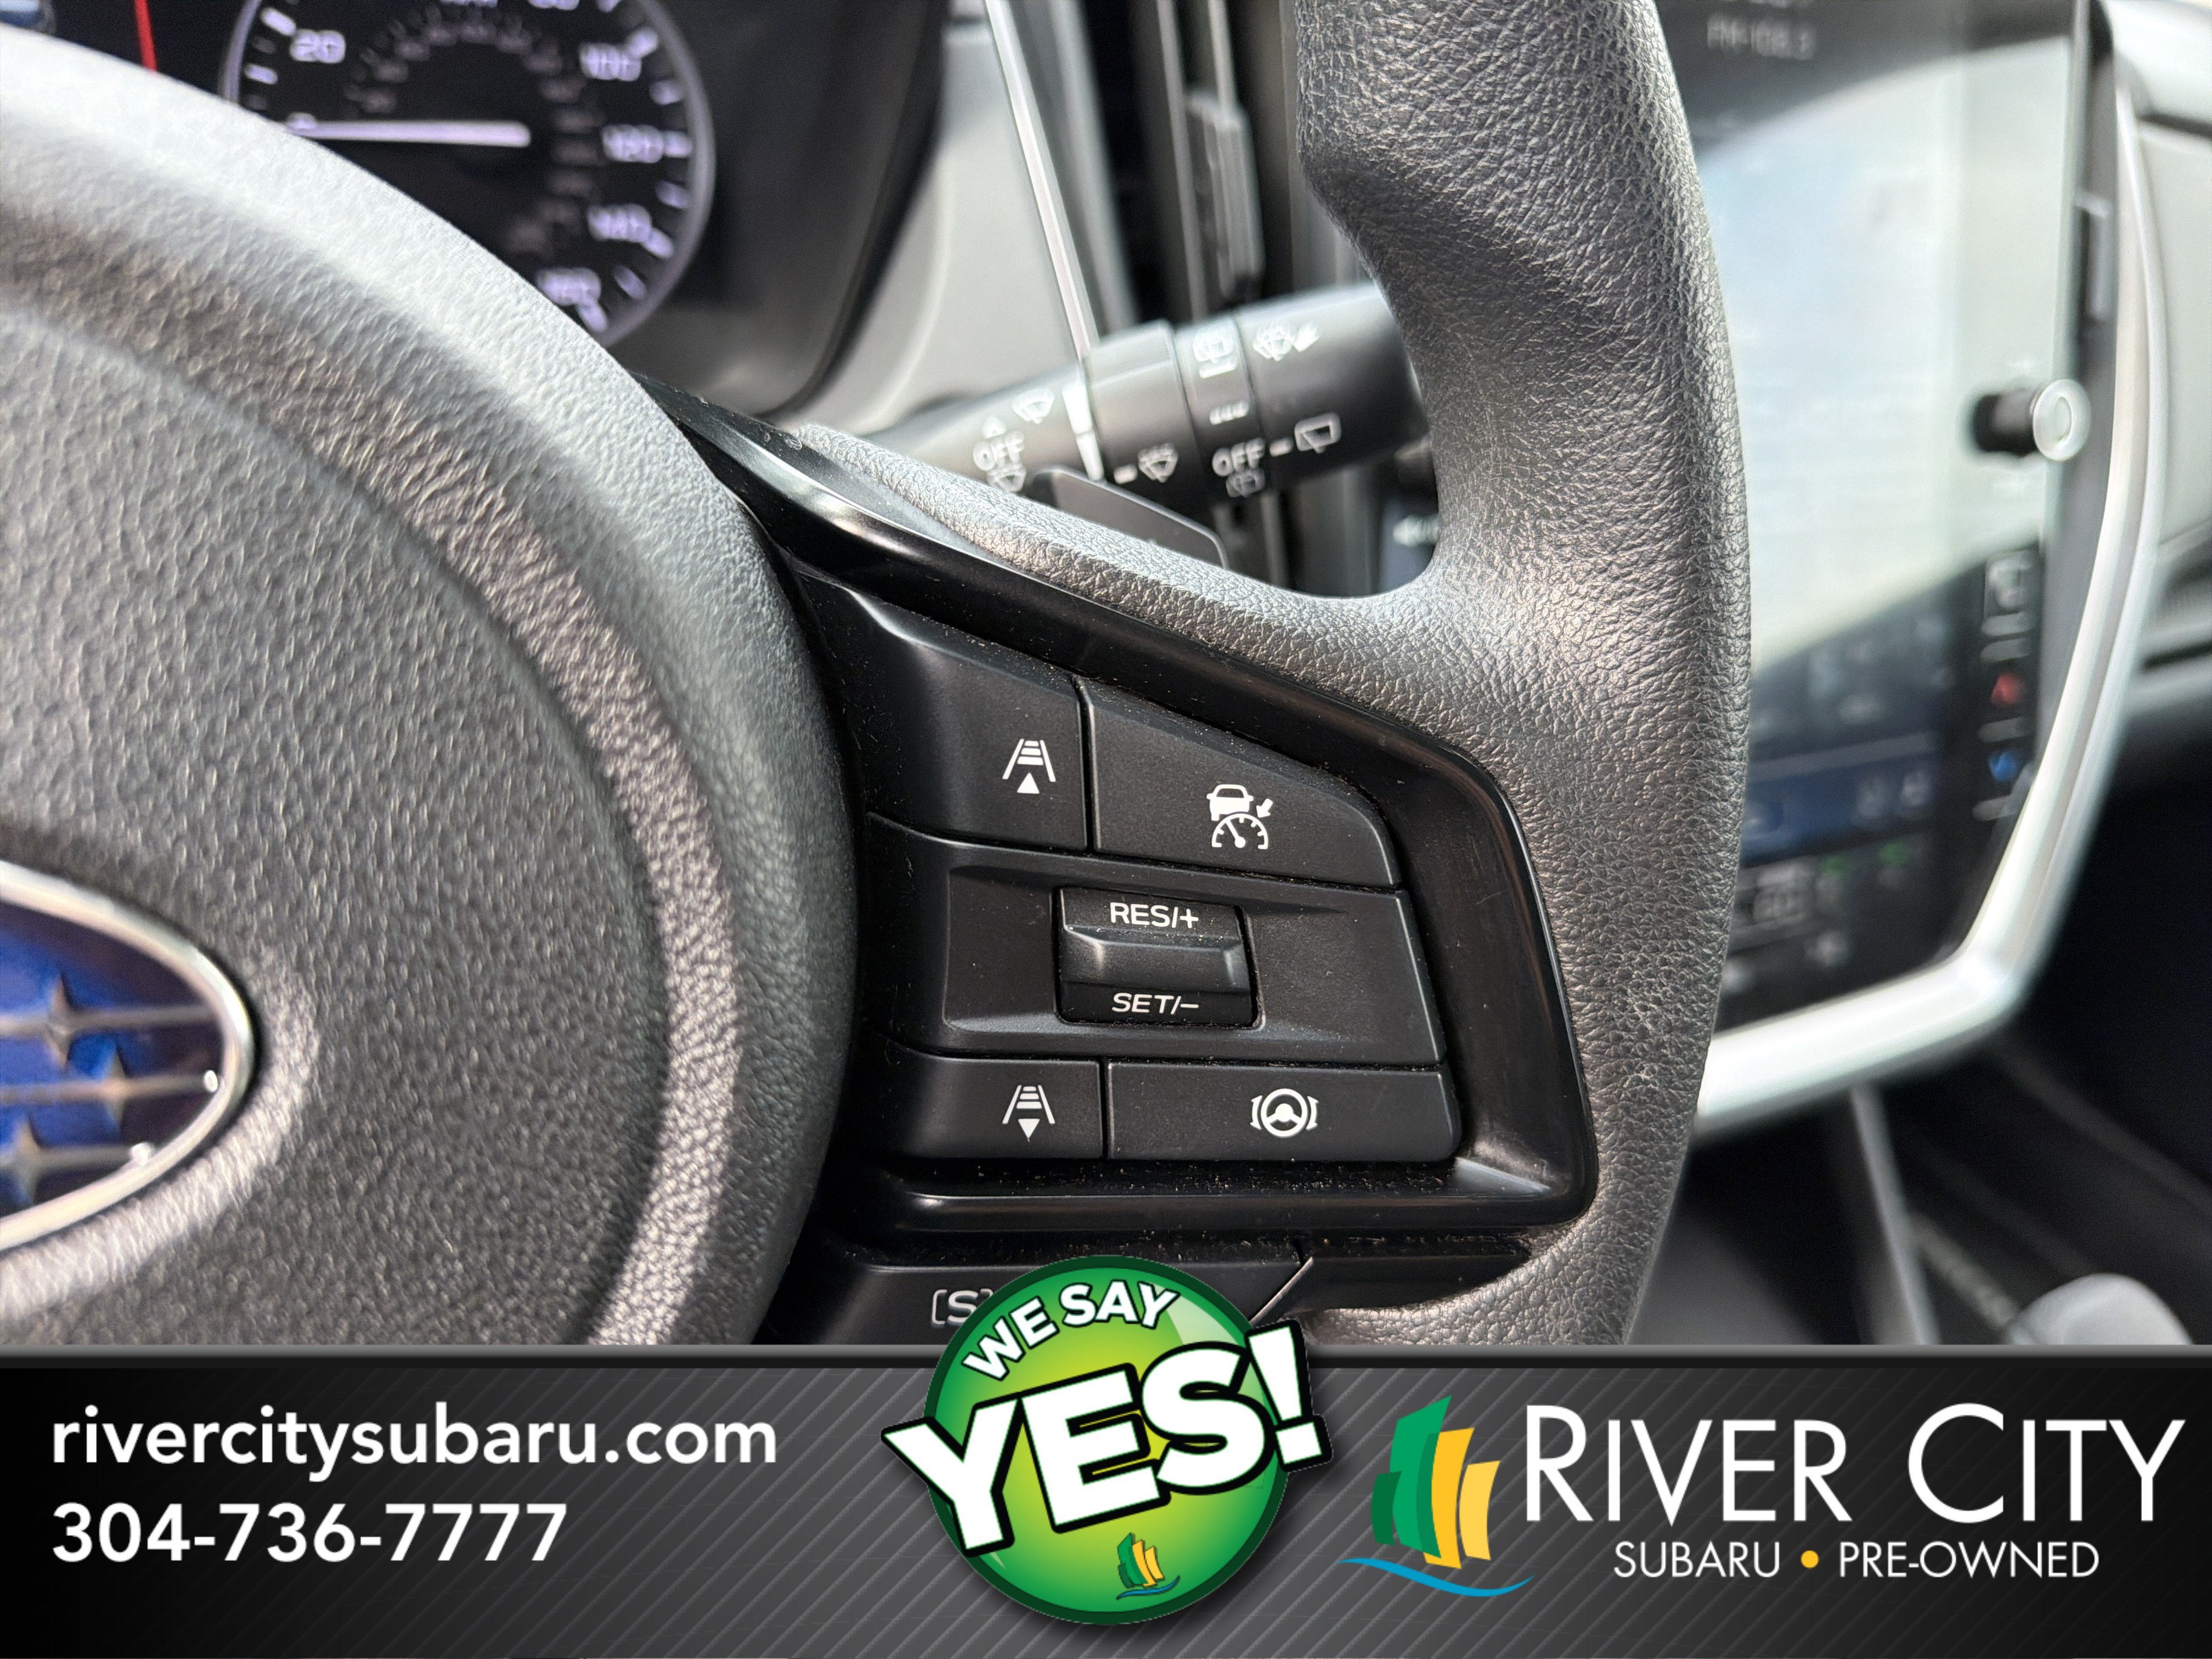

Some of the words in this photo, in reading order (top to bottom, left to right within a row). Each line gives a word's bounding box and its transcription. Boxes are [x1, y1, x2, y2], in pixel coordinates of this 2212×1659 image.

[290, 29, 346, 64] 20
[1212, 437, 1266, 477] OFF
[1109, 901, 1199, 929] RES/+
